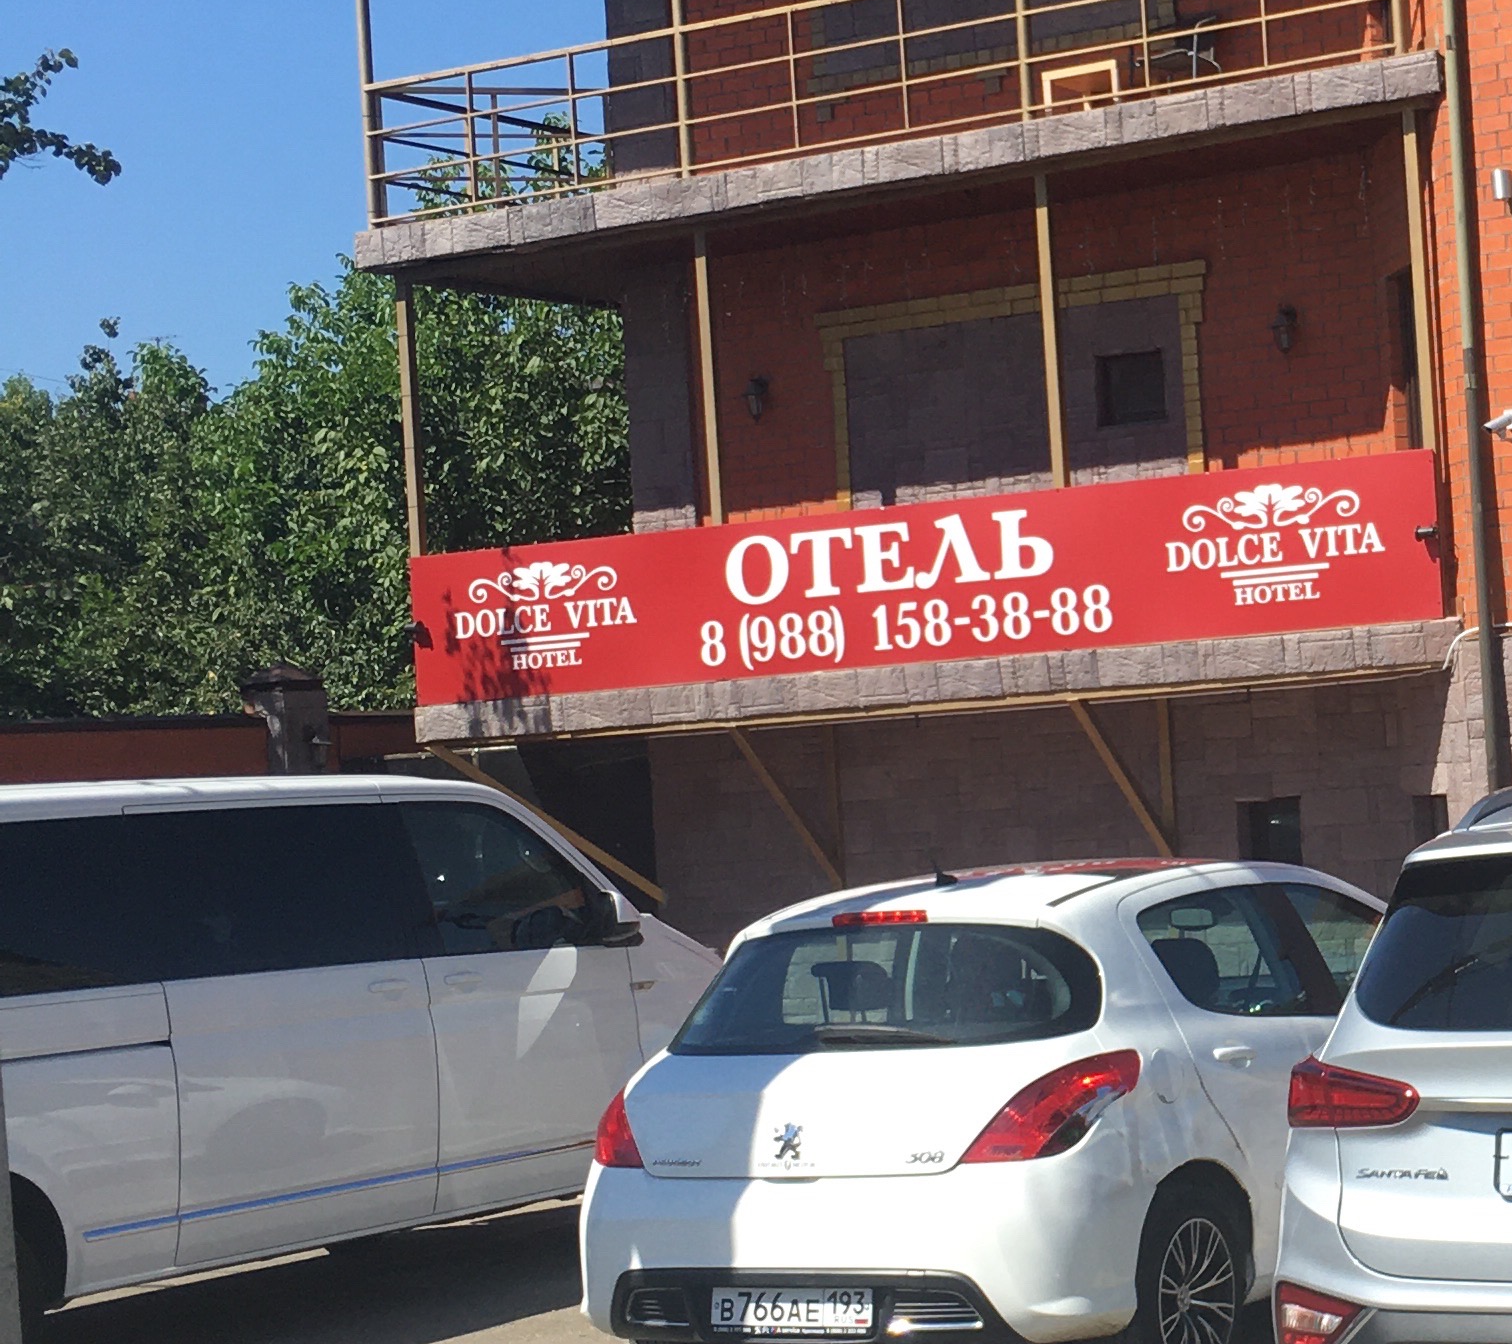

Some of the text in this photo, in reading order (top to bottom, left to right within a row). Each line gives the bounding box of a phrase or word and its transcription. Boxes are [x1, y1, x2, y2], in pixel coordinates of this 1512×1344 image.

[725, 509, 1054, 606] ОТЕЛЬ
[1165, 522, 1386, 573] DOLCE VITA
[1234, 581, 1320, 606] HOTEL
[455, 596, 638, 640] DOLCE VITA
[701, 584, 1113, 671] 8 (988) 158-38-88
[512, 649, 583, 671] HOTEL
[827, 1291, 866, 1315] 193
